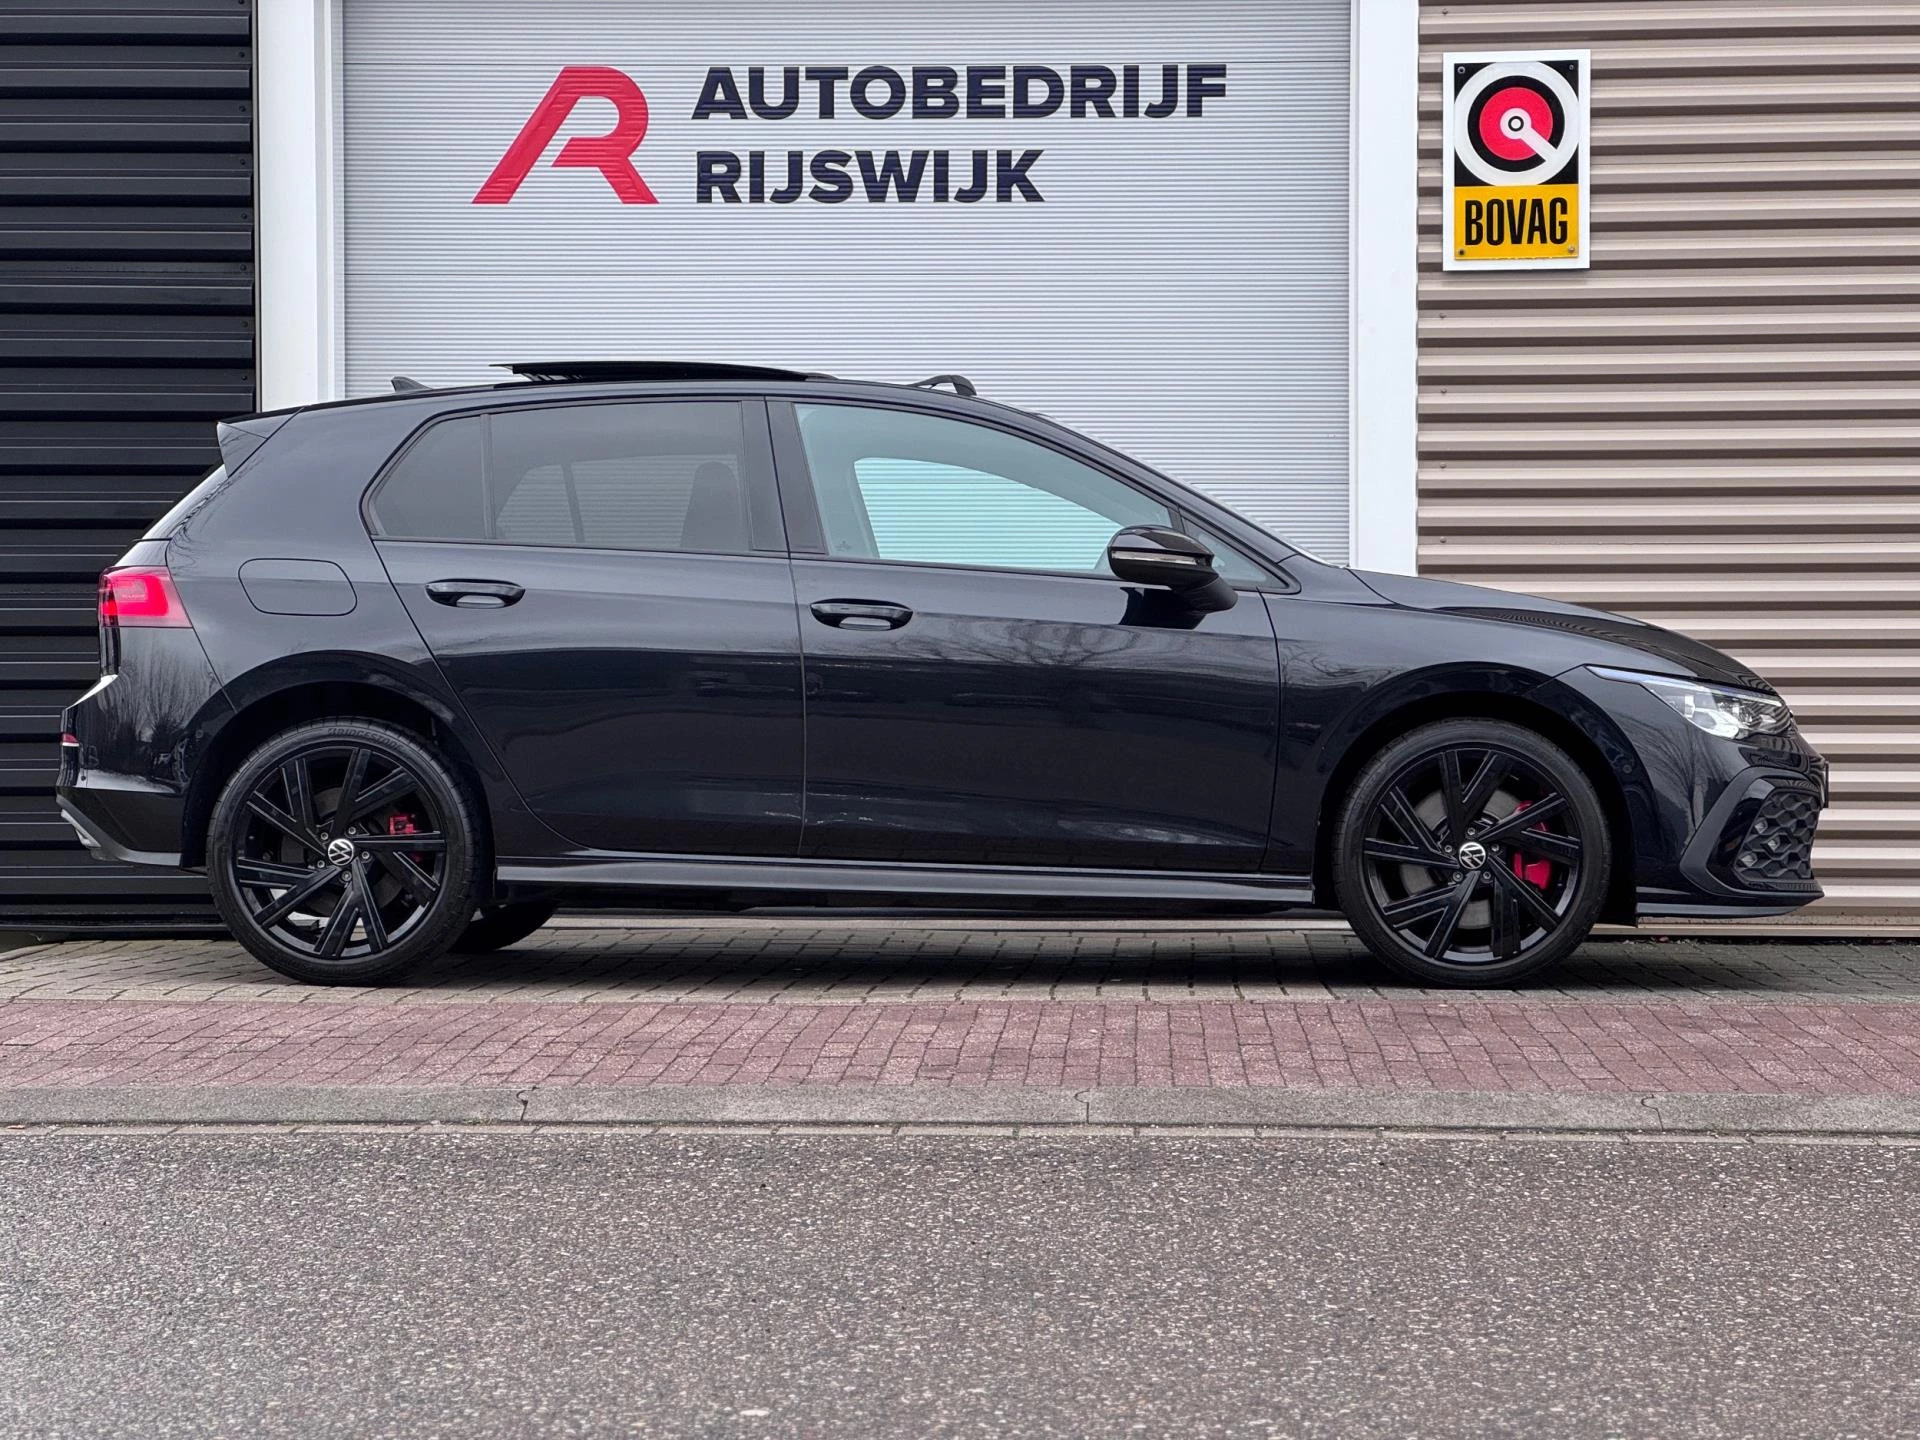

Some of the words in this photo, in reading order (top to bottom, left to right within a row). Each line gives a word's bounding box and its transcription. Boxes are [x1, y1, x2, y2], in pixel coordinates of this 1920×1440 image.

[691, 64, 1227, 120] AUTOBEDRIJF
[696, 149, 1046, 204] RIJSWIJK
[1465, 197, 1568, 245] BOVAG
